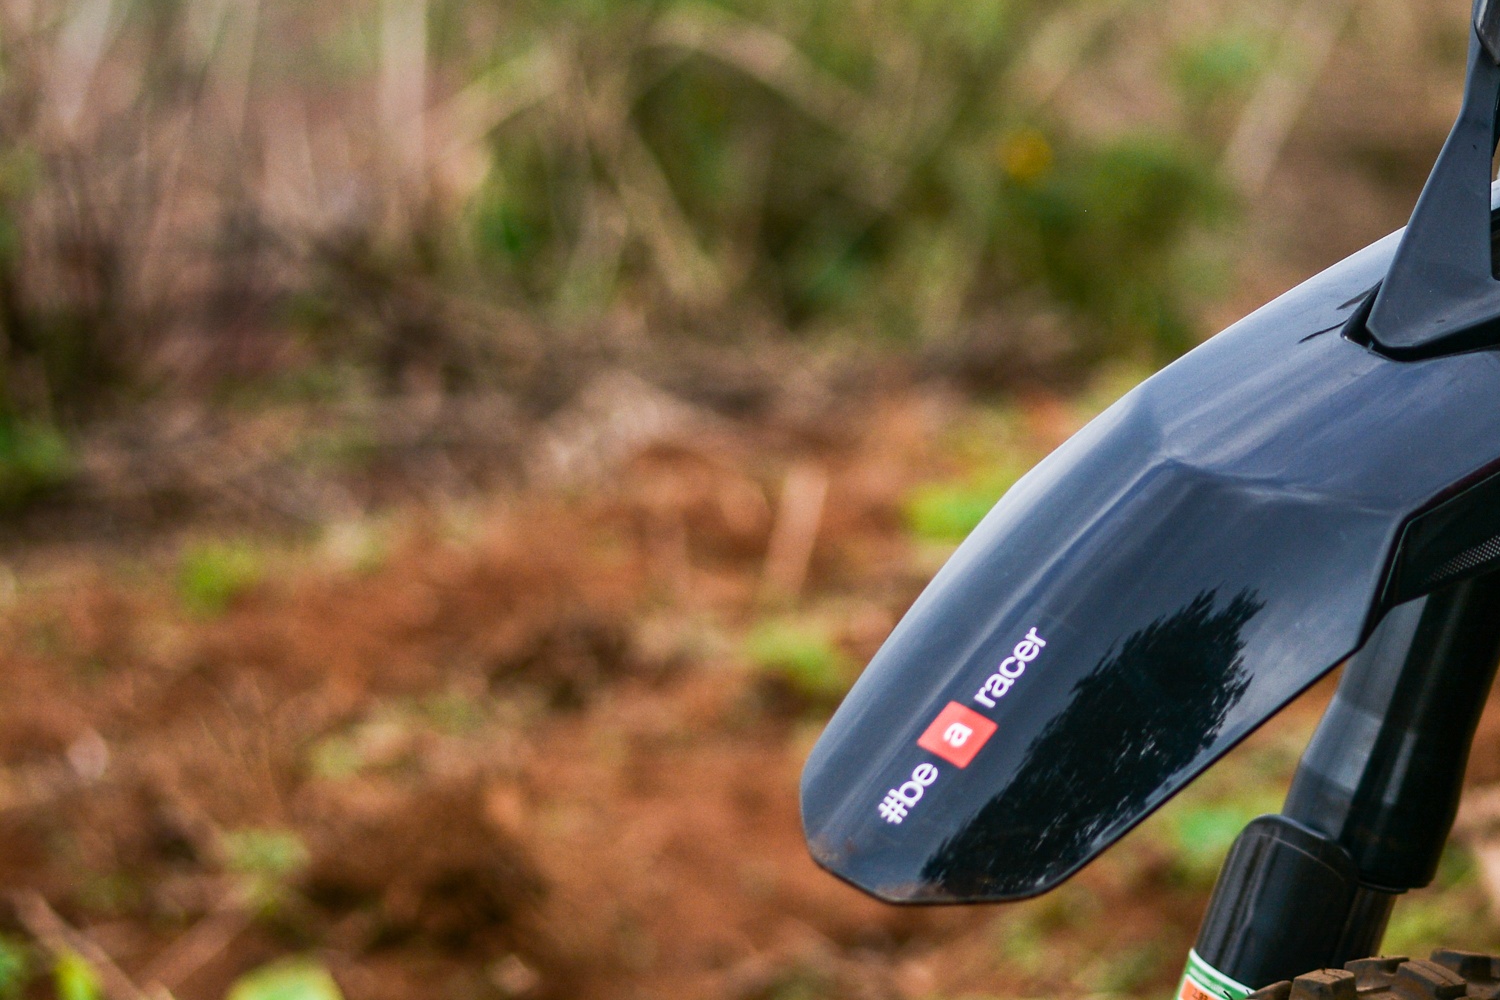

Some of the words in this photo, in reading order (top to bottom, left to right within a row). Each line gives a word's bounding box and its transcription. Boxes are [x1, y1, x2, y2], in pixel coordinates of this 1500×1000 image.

[878, 762, 939, 825] #be
[942, 721, 973, 748] a
[973, 626, 1047, 709] racer
